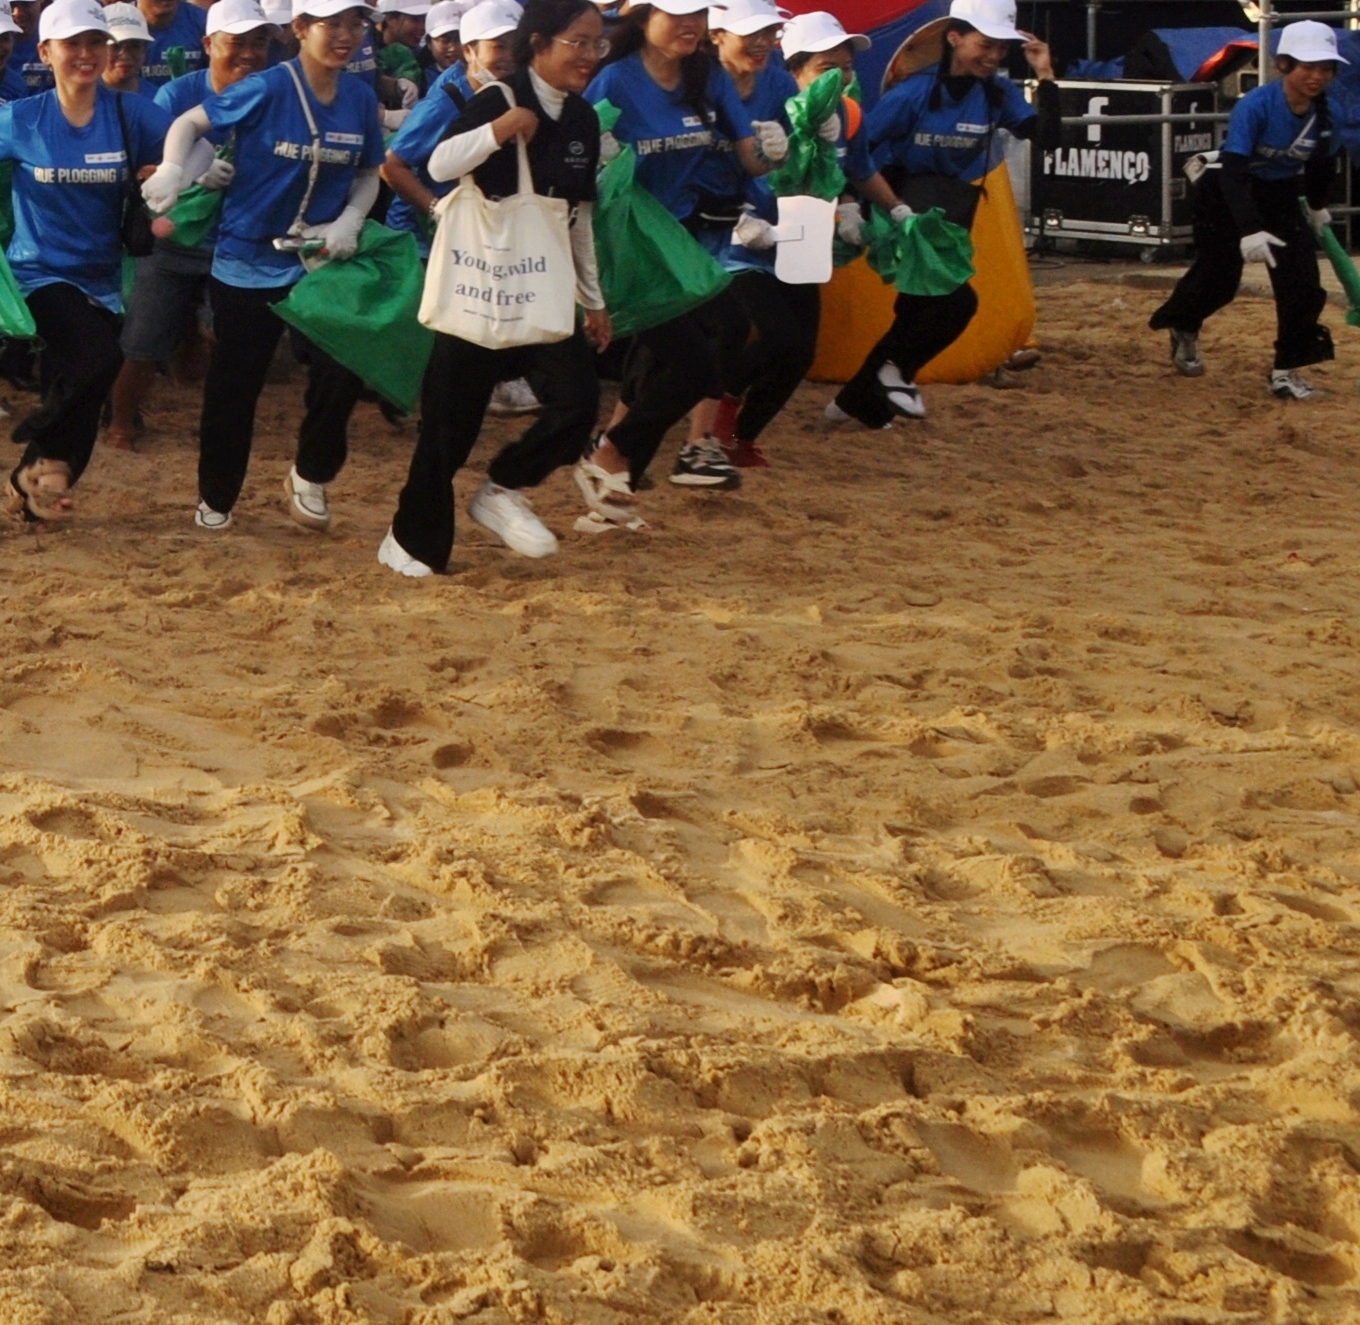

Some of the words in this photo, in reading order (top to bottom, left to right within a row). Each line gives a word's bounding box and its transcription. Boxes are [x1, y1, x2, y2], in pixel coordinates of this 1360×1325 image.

[34, 166, 55, 183] HUE
[58, 168, 117, 184] PLOGGING
[455, 283, 493, 303] and
[495, 289, 537, 306] free
